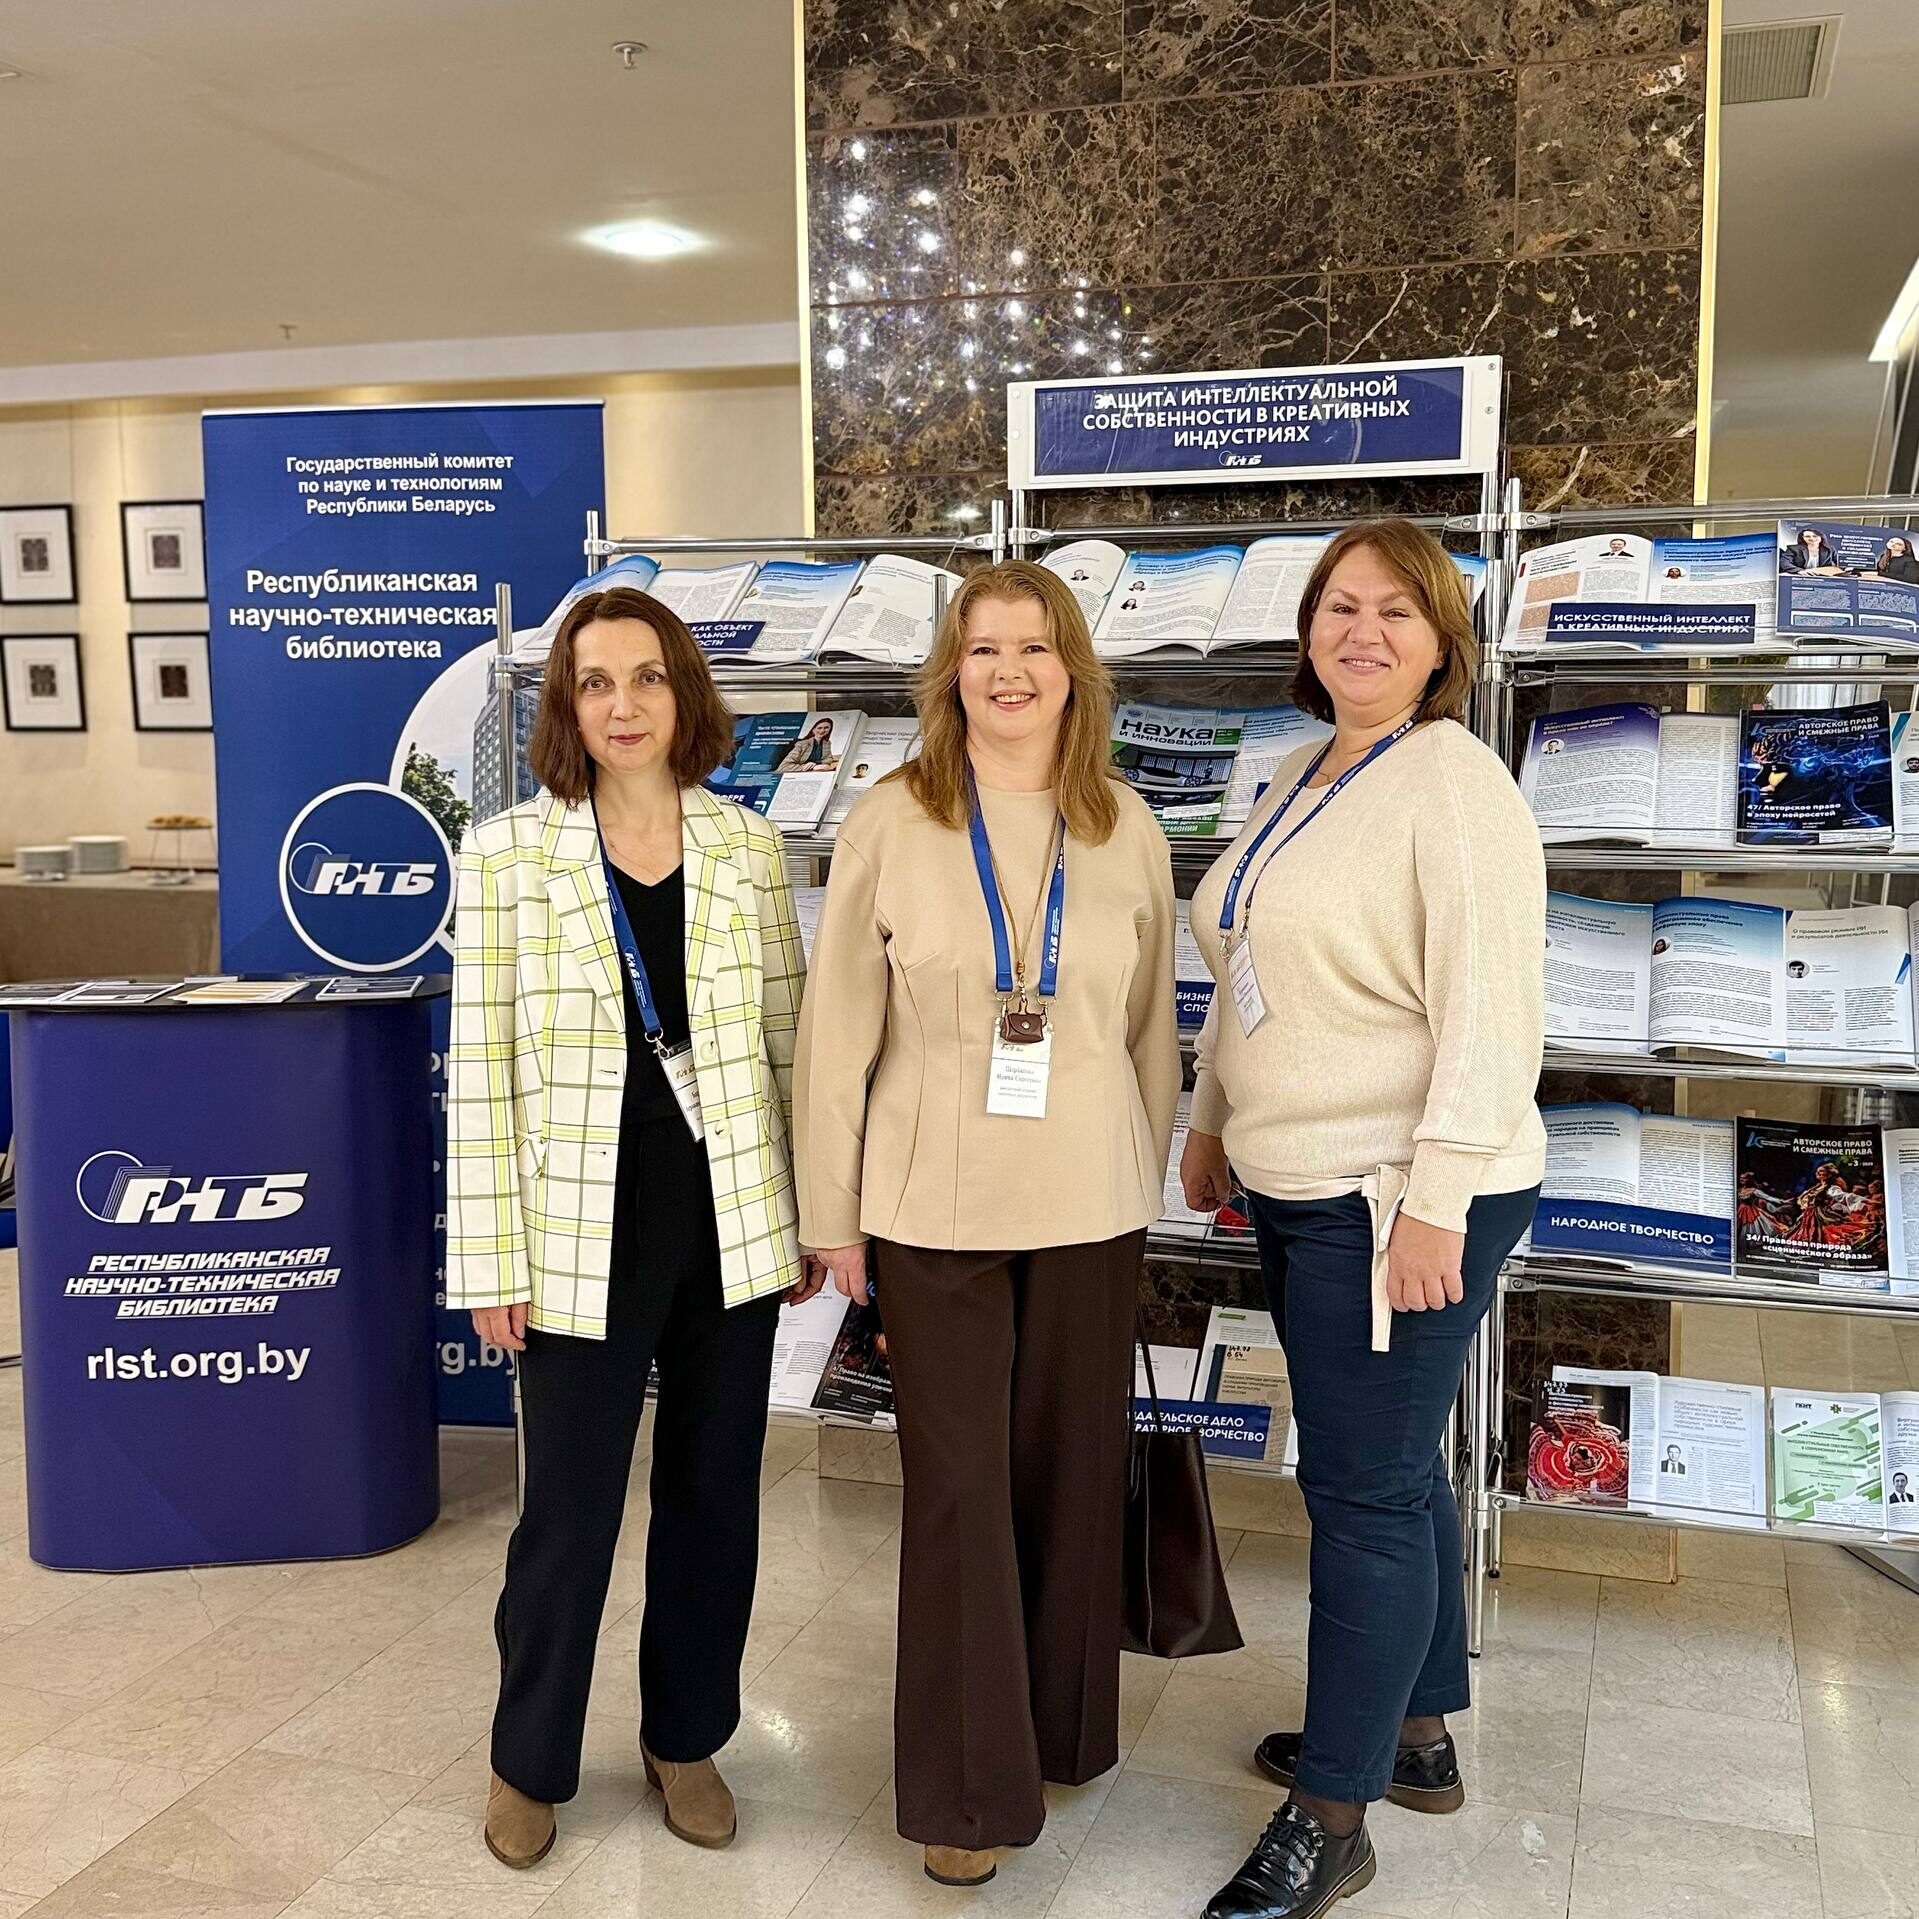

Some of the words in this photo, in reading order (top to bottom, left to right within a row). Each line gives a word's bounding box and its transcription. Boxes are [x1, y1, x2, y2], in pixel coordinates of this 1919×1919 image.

[1094, 391, 1177, 415] ЗАЩИТА
[1181, 375, 1398, 407] ИНТЕЛЛЕКТУАЛЬНОЙ
[1083, 408, 1251, 431] СОБСТВЕННОСТИ
[1256, 406, 1268, 423] В
[1272, 400, 1411, 423] КРЕАТИВНЫХ
[1174, 426, 1310, 449] ИНДУСТРИЯХ
[286, 453, 439, 473] Государственный
[443, 454, 514, 470] комитет
[298, 480, 319, 494] по
[323, 478, 371, 493] науке
[376, 479, 387, 491] и
[390, 475, 503, 492] технологиям
[306, 498, 407, 515] Республики
[412, 497, 496, 516] Беларусь
[247, 569, 478, 599] Республиканская
[229, 604, 498, 632] научно-техническая
[1554, 613, 1673, 623] ИСКУССТВЕННЫЙ
[1676, 615, 1751, 624] ИНТЕЛЛЕКТ
[1567, 622, 1655, 633] КРЕАТИВНЫХ
[1658, 624, 1750, 634] ИНДУСТРИЯХ
[286, 634, 442, 660] библиотека
[1121, 719, 1214, 740] Наука
[1799, 719, 1849, 730] АВТОРСКОЕ
[1849, 715, 1880, 726] ПРАВО
[1806, 726, 1850, 736] СМЕЖНЫЕ
[1851, 722, 1879, 732] ПРАВА
[1131, 732, 1212, 747] инновации
[1782, 810, 1836, 818] нейросетей
[1813, 803, 1842, 811] право
[1792, 1137, 1843, 1148] АВТОРСКОЕ
[1843, 1139, 1873, 1147] ПРАВО
[1800, 1146, 1844, 1155] СМЕЖНЫЕ
[1844, 1147, 1873, 1155] ПРАВА
[1551, 1216, 1627, 1233] НАРОДНОЕ
[1629, 1223, 1715, 1245] ТВОРЧЕСТВО
[1762, 1235, 1809, 1247] Правовая
[1810, 1241, 1852, 1251] природа
[90, 1247, 331, 1273] РЕСПУБЛИКАНСКАЯ
[1762, 1246, 1831, 1258] «сценического
[1832, 1252, 1873, 1260] образа»
[65, 1268, 341, 1295] НАУЧНО-ТЕХНИЧЕСКАЯ
[117, 1295, 279, 1318] БИБЛИОТЕКА
[87, 1342, 311, 1384] rlst.org.by
[1210, 1416, 1245, 1428] ДЕЛО
